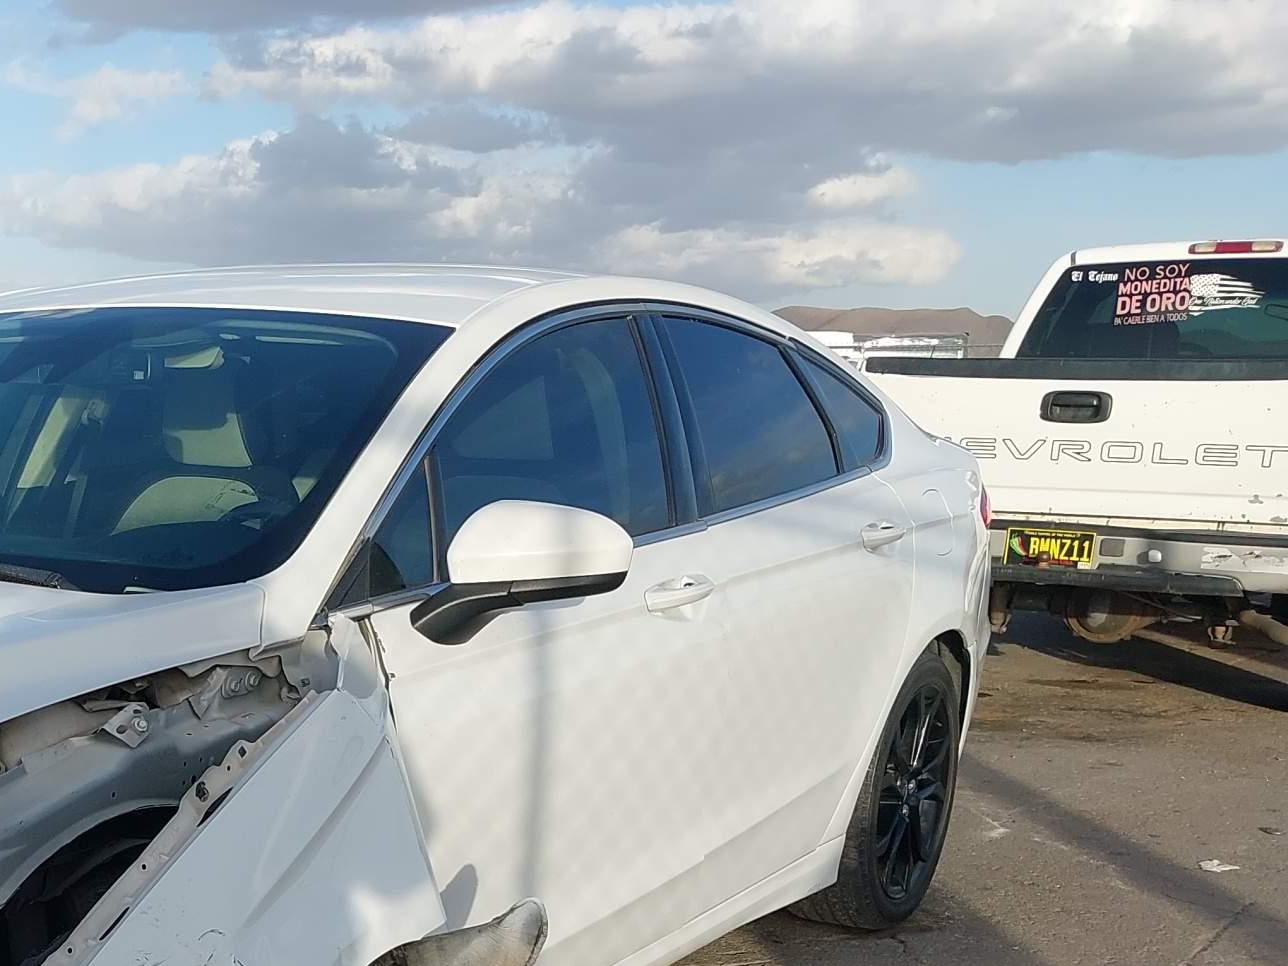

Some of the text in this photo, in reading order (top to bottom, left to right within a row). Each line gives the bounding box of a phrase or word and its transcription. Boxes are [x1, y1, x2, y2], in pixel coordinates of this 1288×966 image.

[1071, 270, 1119, 283] El Tejano
[1124, 263, 1191, 281] NO SOY
[1118, 278, 1191, 294] MONEDITA
[1116, 293, 1190, 315] DE ORO
[1166, 312, 1188, 322] TODOS
[944, 436, 1288, 468] EVROLET
